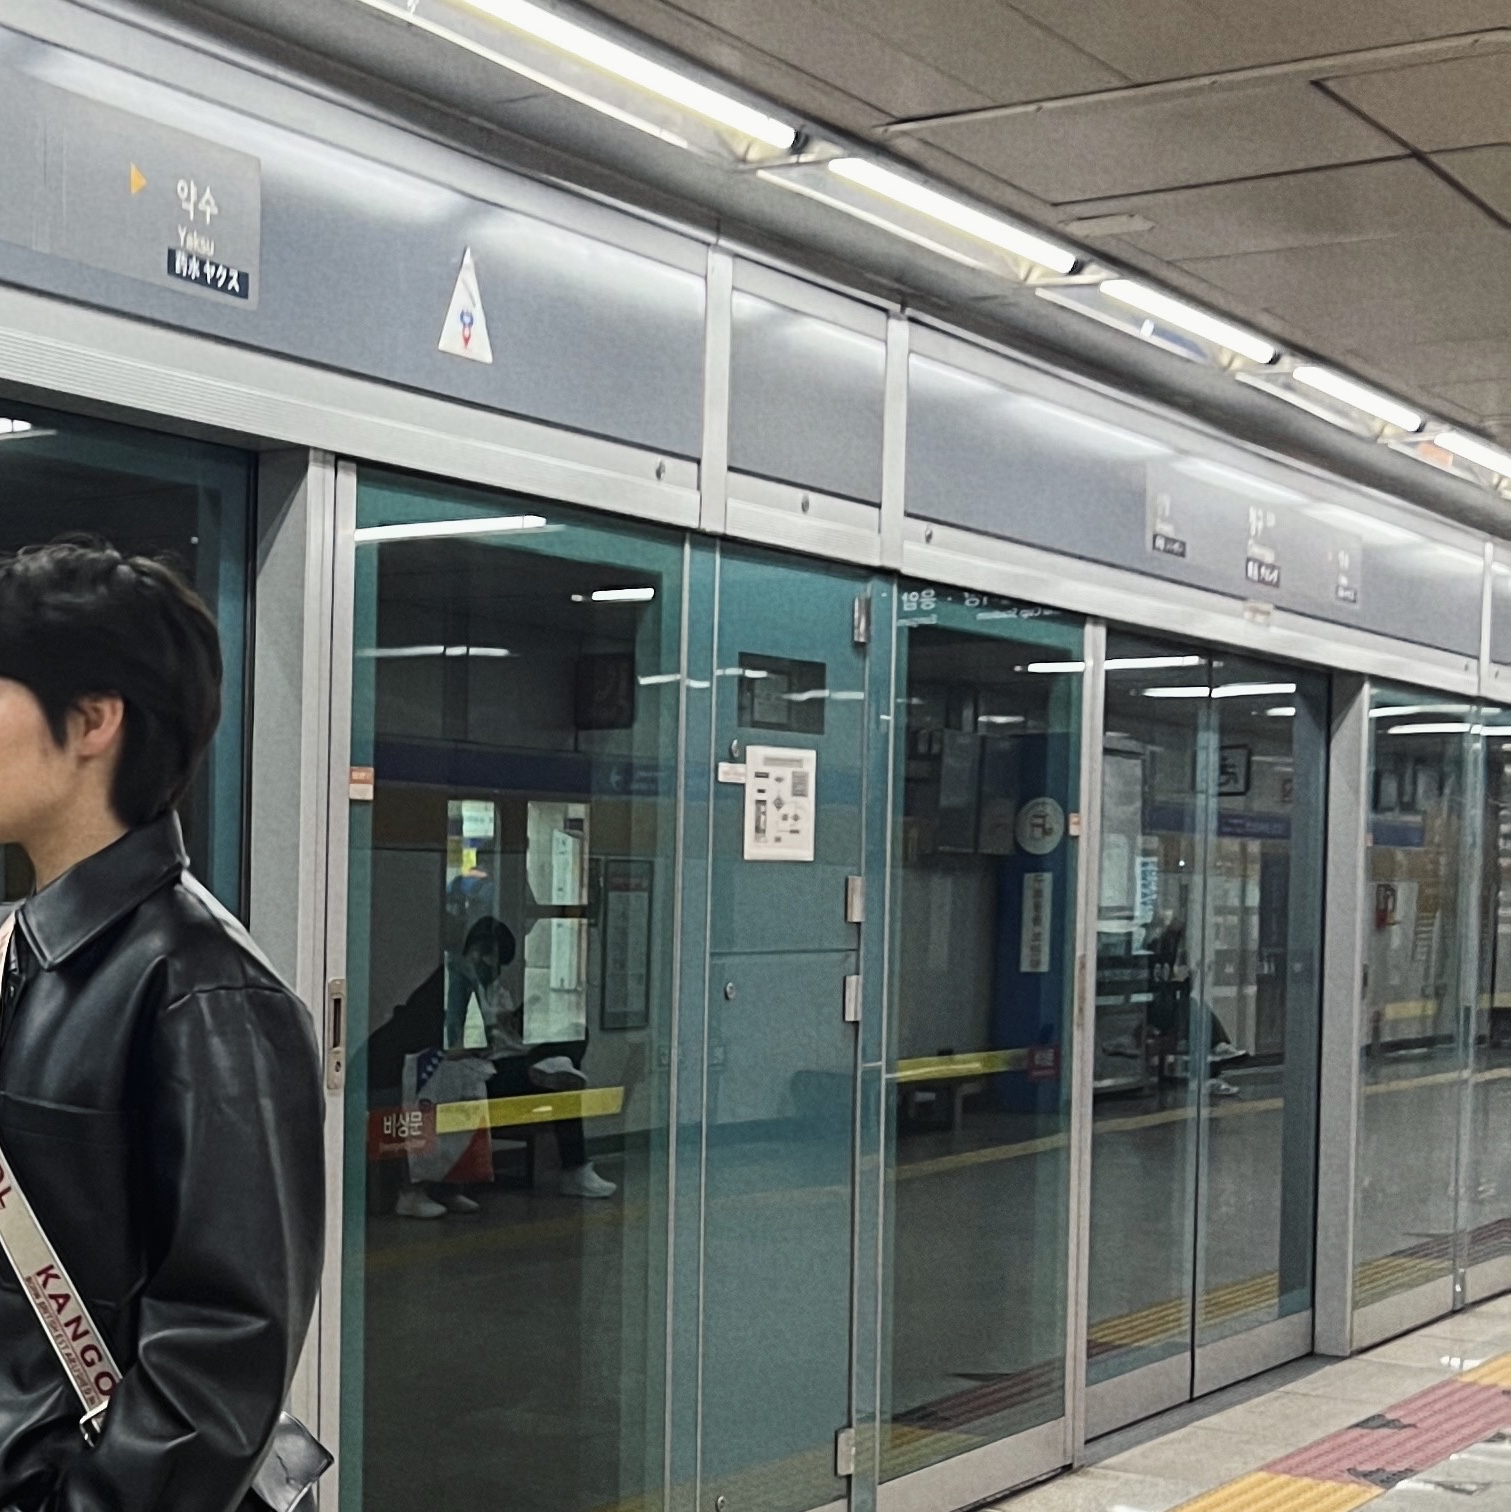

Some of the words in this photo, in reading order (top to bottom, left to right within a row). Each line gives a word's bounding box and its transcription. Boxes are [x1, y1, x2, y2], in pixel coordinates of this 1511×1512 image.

[176, 178, 219, 225] 약수
[383, 1110, 424, 1138] 비상문
[36, 1264, 117, 1397] KANGO
